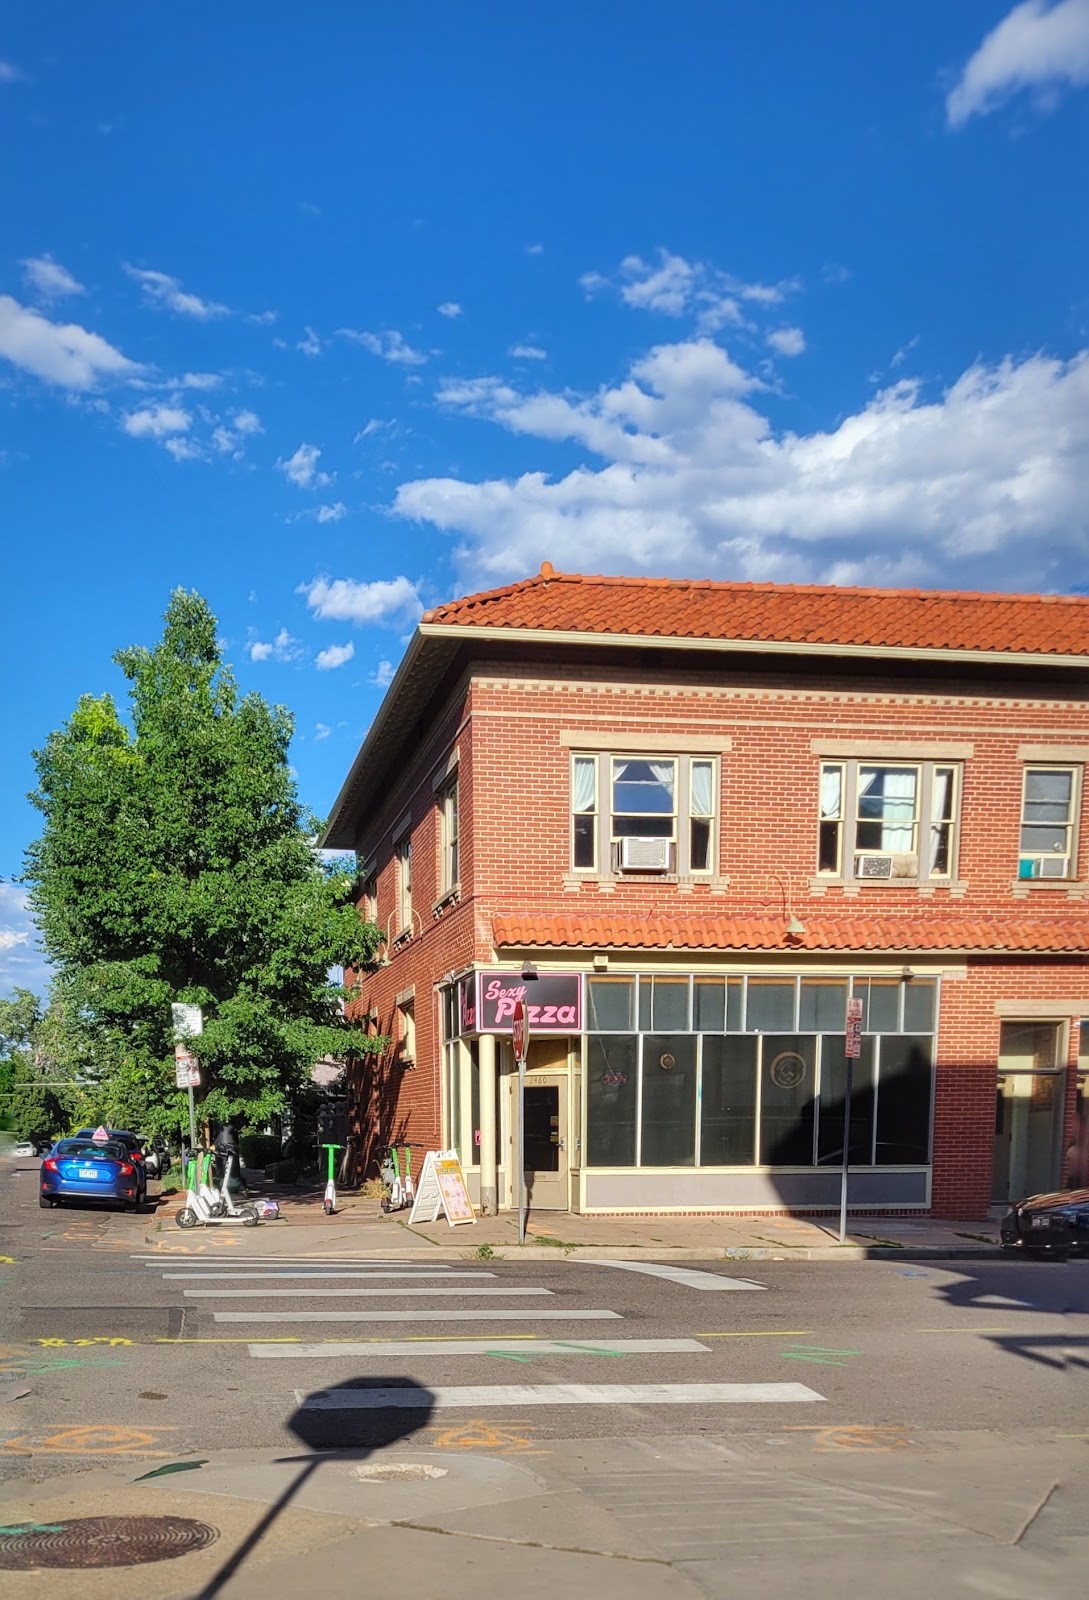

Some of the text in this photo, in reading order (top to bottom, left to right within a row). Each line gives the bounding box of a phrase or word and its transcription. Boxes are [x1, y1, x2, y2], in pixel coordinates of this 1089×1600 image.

[485, 980, 527, 1001] Sexy
[494, 998, 576, 1024] Pzza
[529, 1076, 547, 1085] 2460
